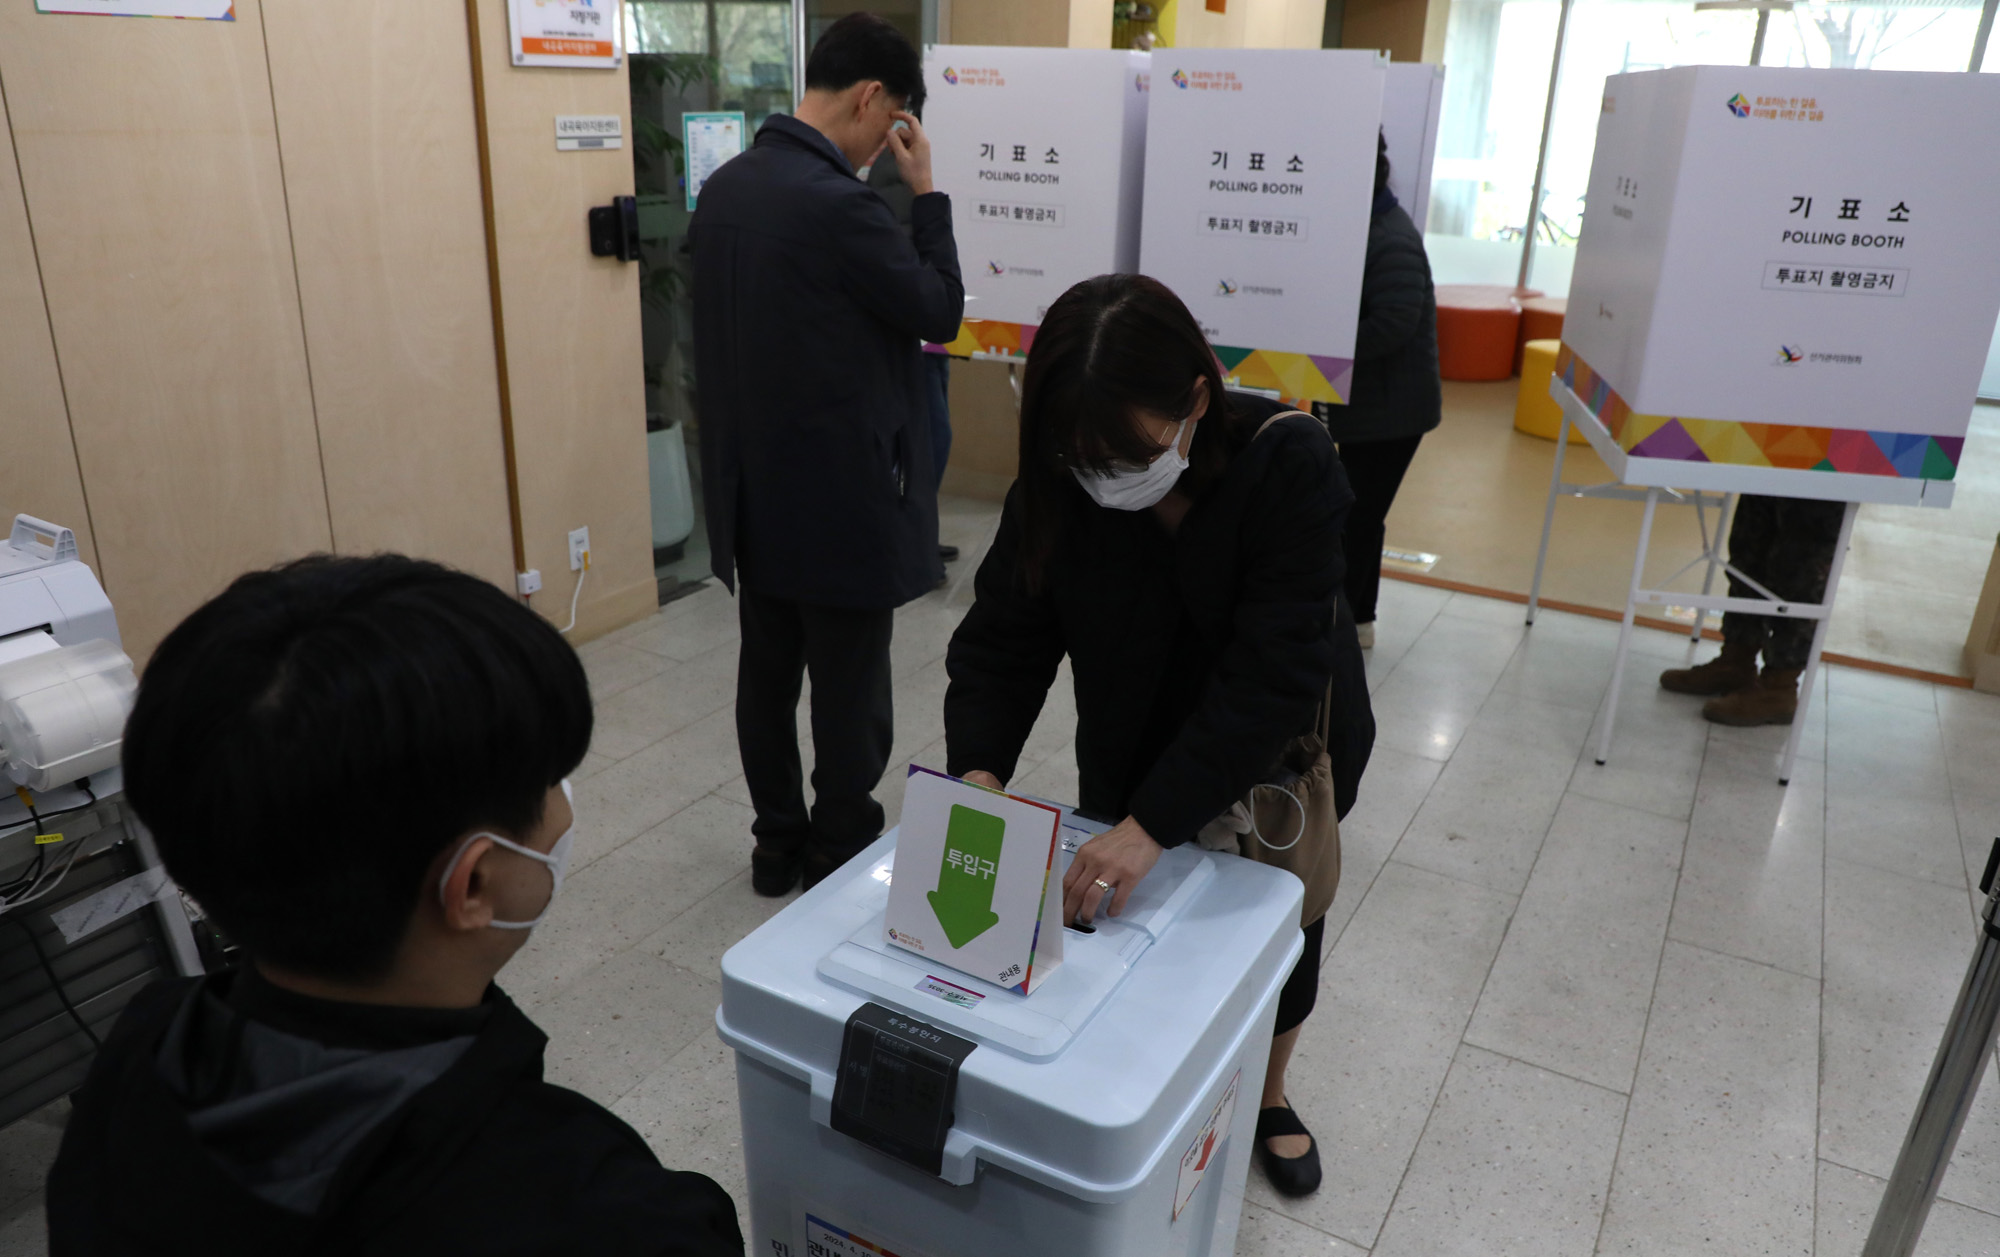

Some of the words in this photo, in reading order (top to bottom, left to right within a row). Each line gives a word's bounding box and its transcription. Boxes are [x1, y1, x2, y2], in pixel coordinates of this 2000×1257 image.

[979, 170, 1021, 182] POLLING
[1024, 173, 1059, 184] BOOTH
[1209, 180, 1258, 193] POLLING
[1261, 182, 1303, 195] BOOTH
[978, 204, 1009, 218] 투표지
[1013, 206, 1056, 222] 촬영금지
[1207, 216, 1243, 233] 투표지
[1248, 218, 1299, 236] 촬영금지
[1782, 230, 1846, 246] POLLING
[1851, 234, 1905, 248] BOOTH
[1775, 267, 1824, 286] 투표지
[1830, 270, 1895, 290] 촬영금지
[946, 848, 996, 880] 투입구
[998, 963, 1021, 982] 관내용
